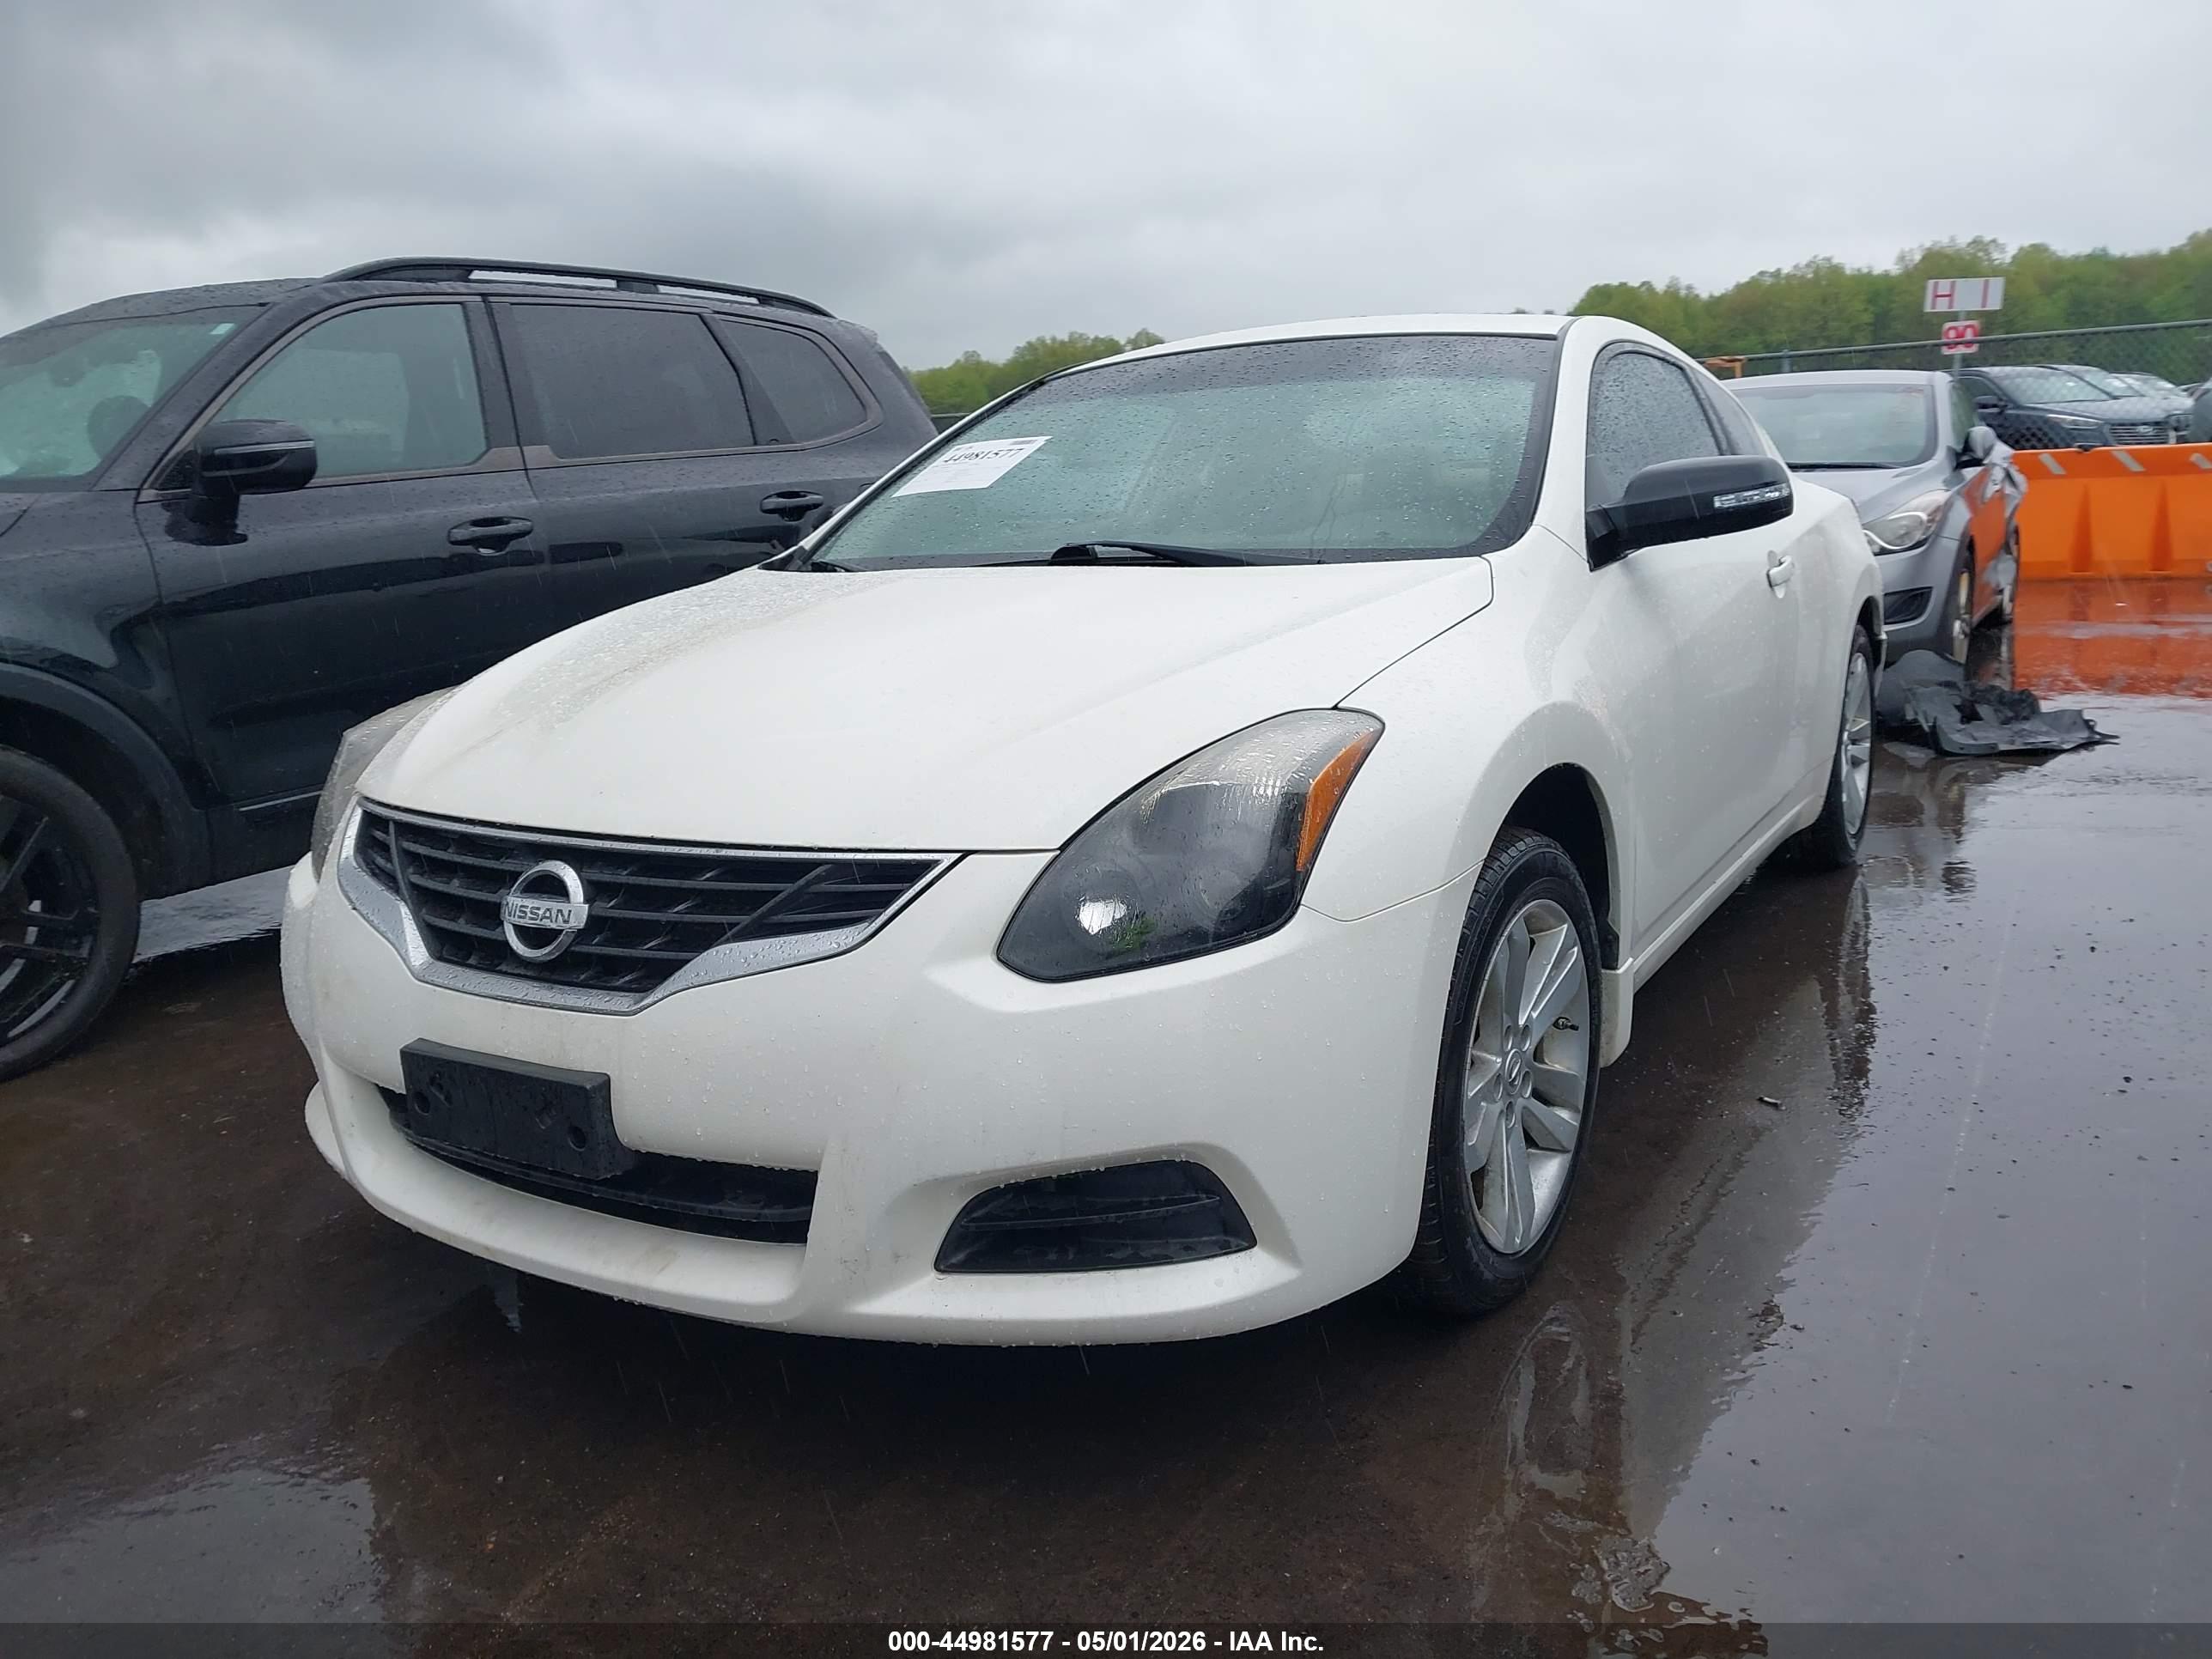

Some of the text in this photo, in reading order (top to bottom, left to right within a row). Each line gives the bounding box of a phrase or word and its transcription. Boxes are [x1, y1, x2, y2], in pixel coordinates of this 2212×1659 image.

[1930, 281, 1957, 310] H
[1943, 324, 1979, 350] 90
[944, 447, 1025, 463] 44981577
[503, 900, 573, 925] NISSAN
